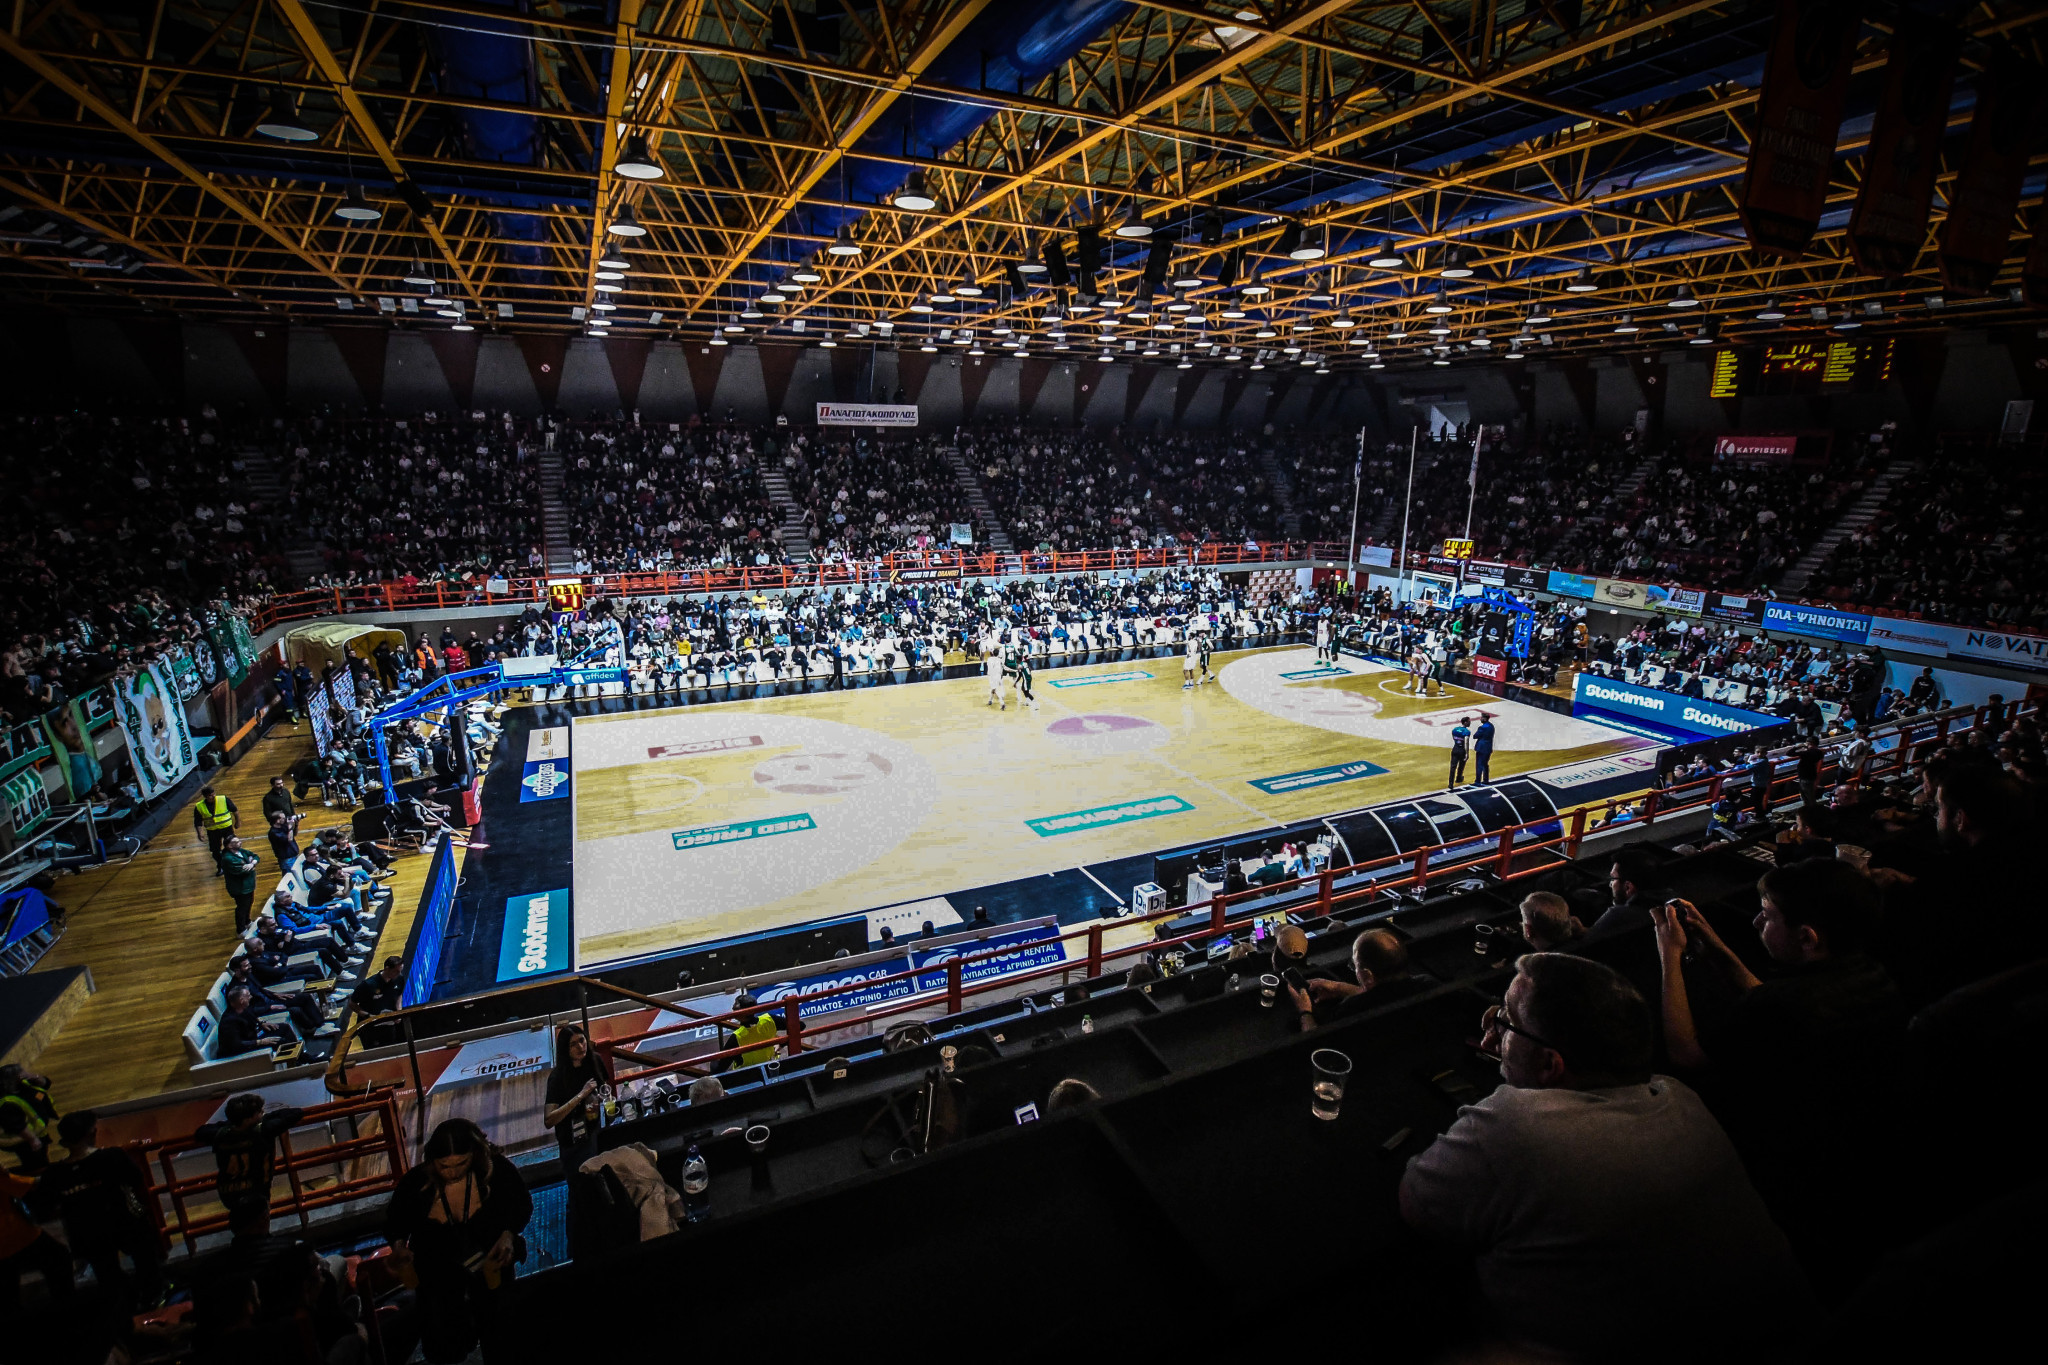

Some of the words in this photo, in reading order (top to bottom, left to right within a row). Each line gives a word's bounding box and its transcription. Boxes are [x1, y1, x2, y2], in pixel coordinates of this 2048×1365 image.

[820, 407, 916, 418] ΠΑΝΑΓΙΩΤΑΚΟΠΟΥΛΟΣ
[1967, 632, 2048, 656] NOVAT
[585, 672, 615, 680] affidea
[1477, 667, 1497, 677] COLA
[1585, 684, 1665, 711] Stoiximan
[757, 818, 809, 835] MED
[675, 827, 753, 848] FRIGO
[1024, 945, 1056, 957] RENTAL
[1006, 959, 1035, 971] ΑΓΡΙΝΙΟ
[1040, 954, 1059, 964] ΑΙΓΙΟ
[868, 969, 888, 980] CAR
[800, 1001, 843, 1017] ΑΥΠΑΚΤΟΣ
[850, 992, 882, 1006] ΑΓΡΙΝΙΟ
[888, 986, 909, 998] ΑΙΓΙΟ
[481, 1054, 543, 1074] theocar
